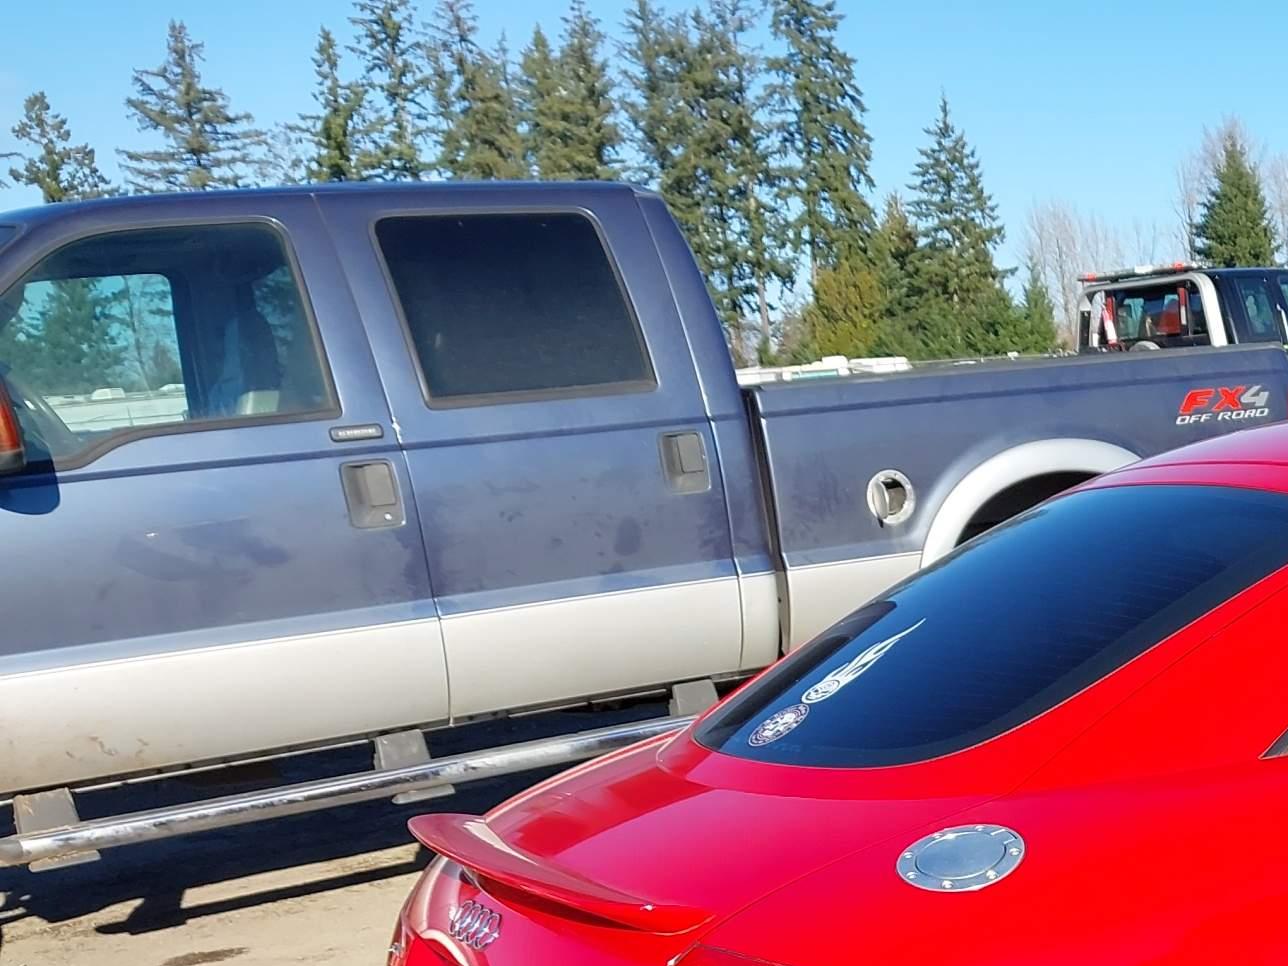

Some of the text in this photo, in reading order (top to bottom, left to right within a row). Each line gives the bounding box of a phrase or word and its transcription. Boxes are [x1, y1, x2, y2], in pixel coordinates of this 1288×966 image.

[1178, 384, 1270, 415] FX4
[1175, 408, 1270, 425] OFF ROAD
